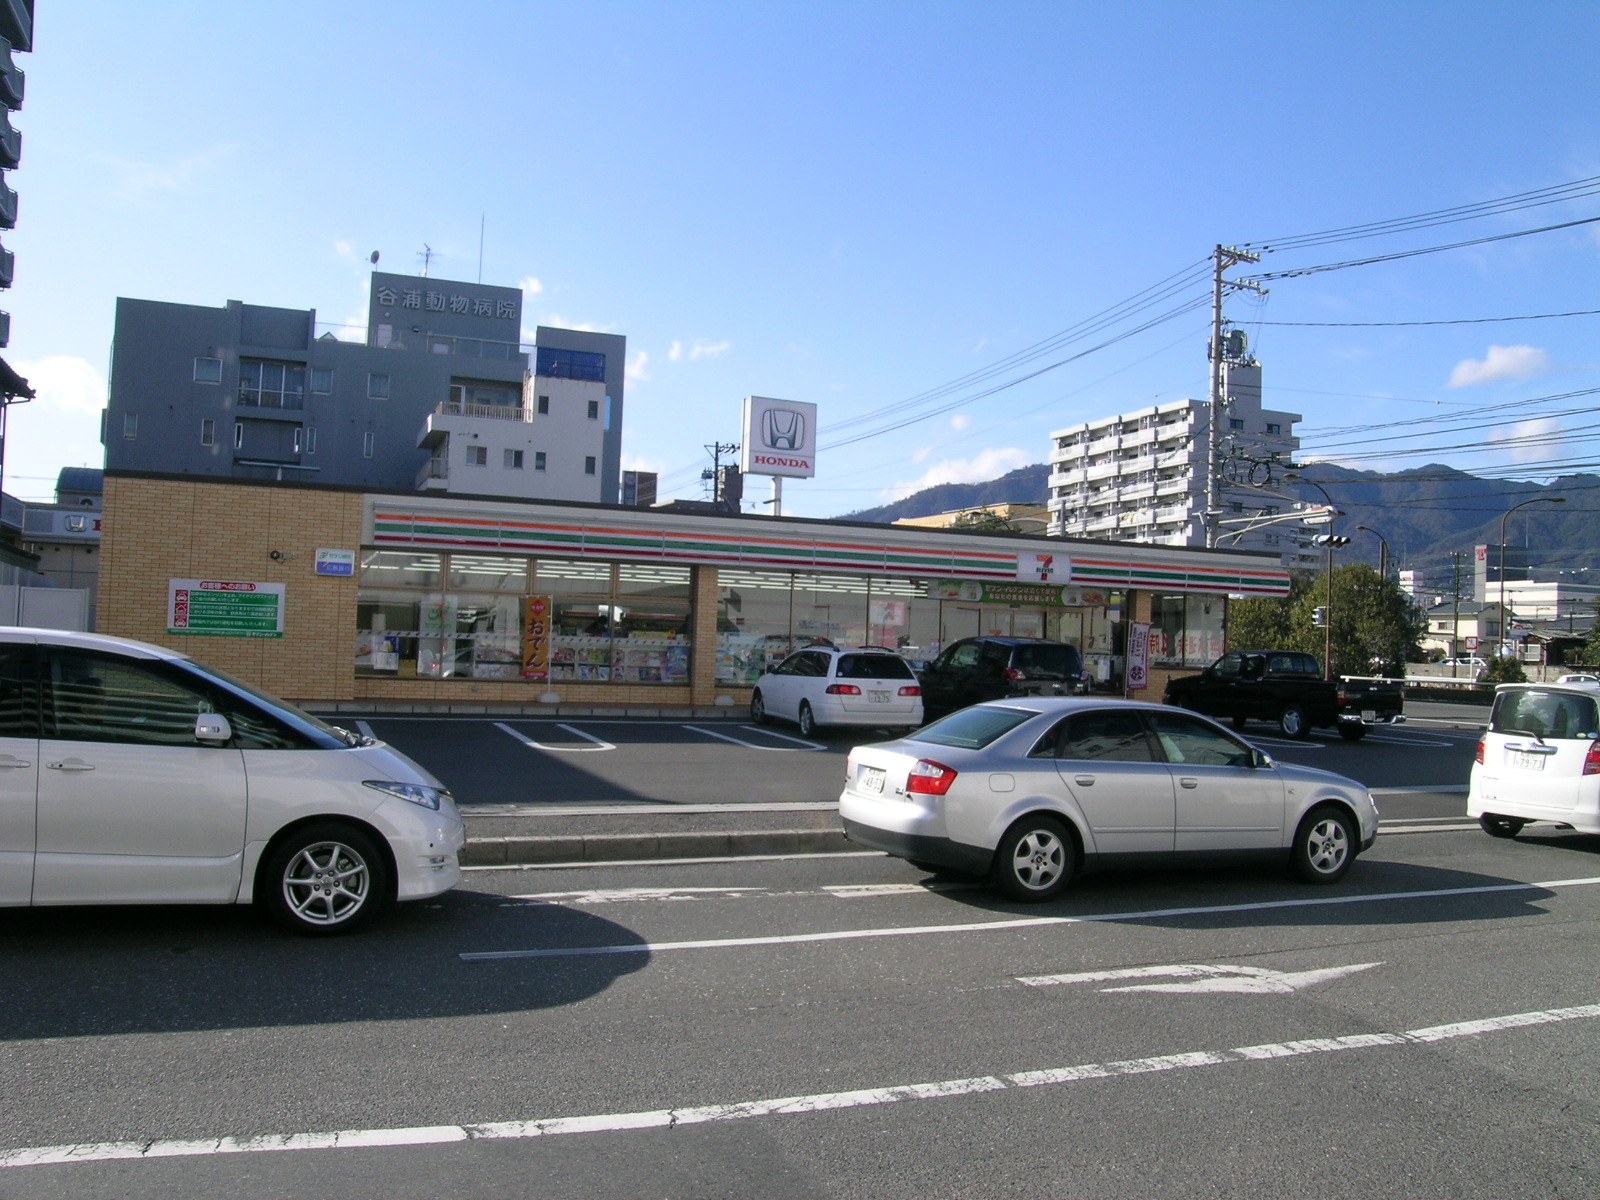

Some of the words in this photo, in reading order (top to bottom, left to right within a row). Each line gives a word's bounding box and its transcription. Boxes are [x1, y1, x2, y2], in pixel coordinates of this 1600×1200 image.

[376, 286, 516, 320] 谷浦動物病院
[754, 455, 810, 469] HONDA
[526, 618, 546, 669] おでん
